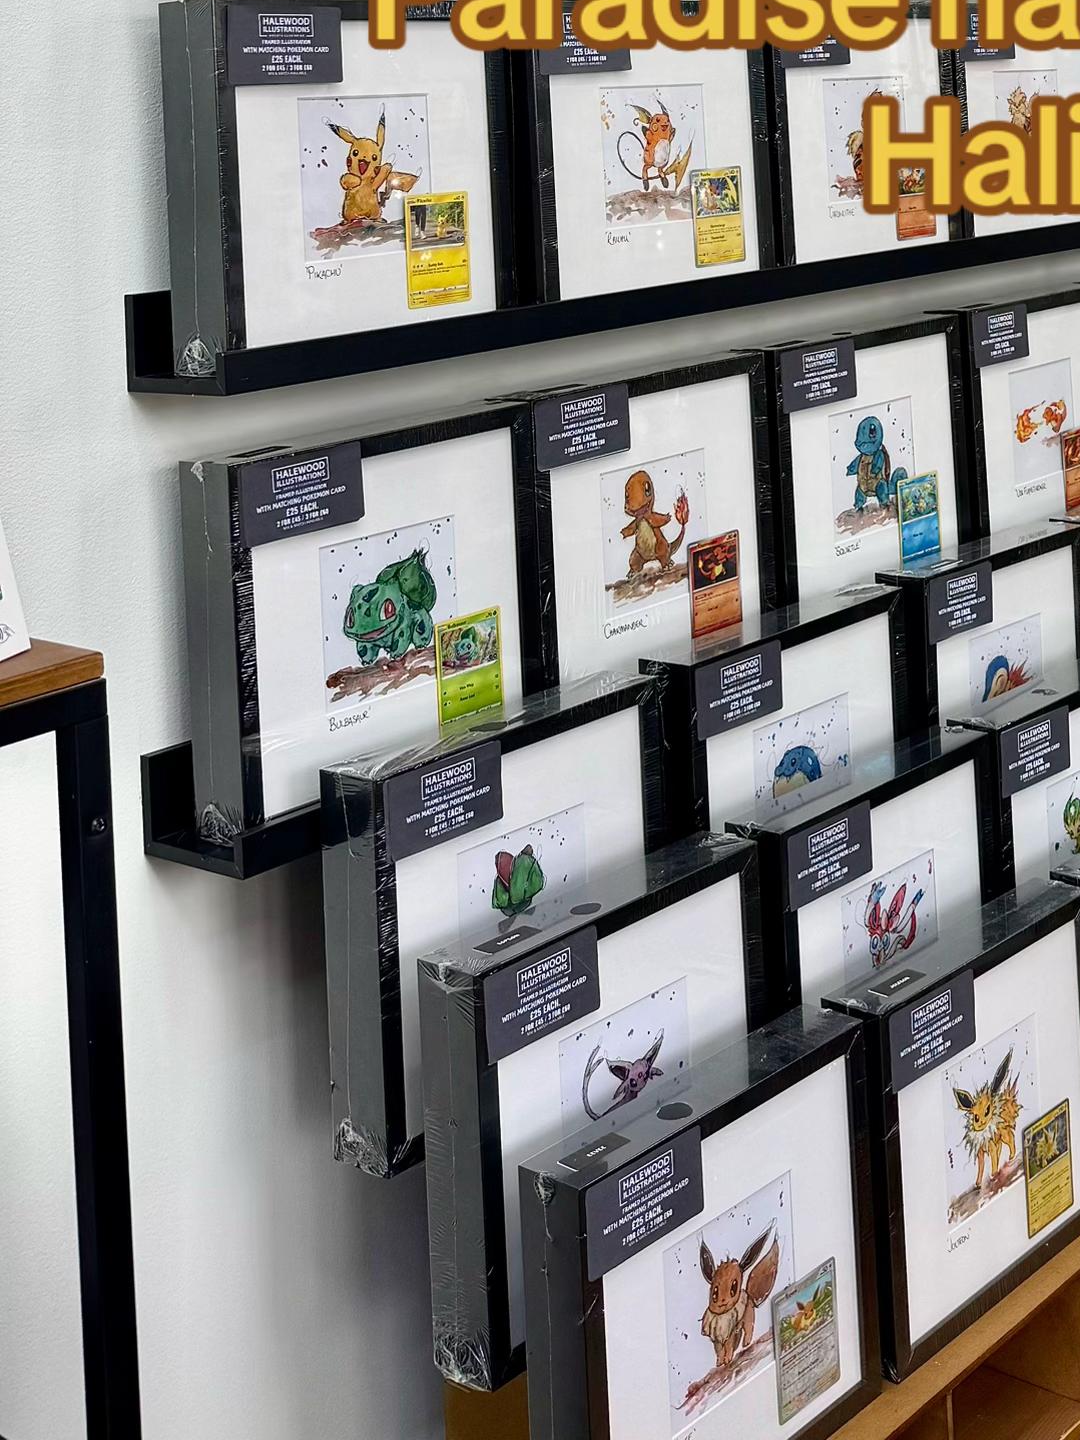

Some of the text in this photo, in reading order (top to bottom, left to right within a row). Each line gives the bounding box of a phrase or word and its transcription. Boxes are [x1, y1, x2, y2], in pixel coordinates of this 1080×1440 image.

[261, 16, 310, 25] HALEWOOD
[262, 25, 310, 33] ILLUSTRATIONS
[314, 45, 329, 53] CARD
[989, 313, 1012, 325] HALEWOOD
[805, 350, 835, 363] HALEWOOD
[563, 397, 602, 413] HALEWOOD
[564, 404, 603, 419] ILLUSTRATIONS
[275, 460, 325, 481] HALEWOOD
[275, 469, 326, 488] ILLUSTRATIONS
[330, 484, 346, 494] CARD
[949, 575, 975, 589] HALEWOOD
[723, 657, 759, 677] HALEWOOD
[723, 665, 759, 685] ILLUSTRATIONS
[1019, 722, 1048, 741] HALEWOOD
[424, 761, 471, 787] HALEWOOD
[425, 770, 472, 795] ILLUSTRATIONS
[475, 783, 490, 796] CARD
[810, 821, 846, 845] HALEWOOD
[811, 829, 846, 852] ILLUSTRATIONS
[520, 951, 568, 982] HALEWOOD
[520, 961, 568, 990] ILLUSTRATIONS
[571, 974, 587, 989] CARD
[913, 993, 948, 1021] HALEWOOD
[914, 1002, 949, 1029] ILLUSTRATIONS
[622, 1154, 669, 1190] HALEWOOD
[622, 1164, 670, 1199] ILLUSTRATIONS
[673, 1177, 688, 1194] CARD
